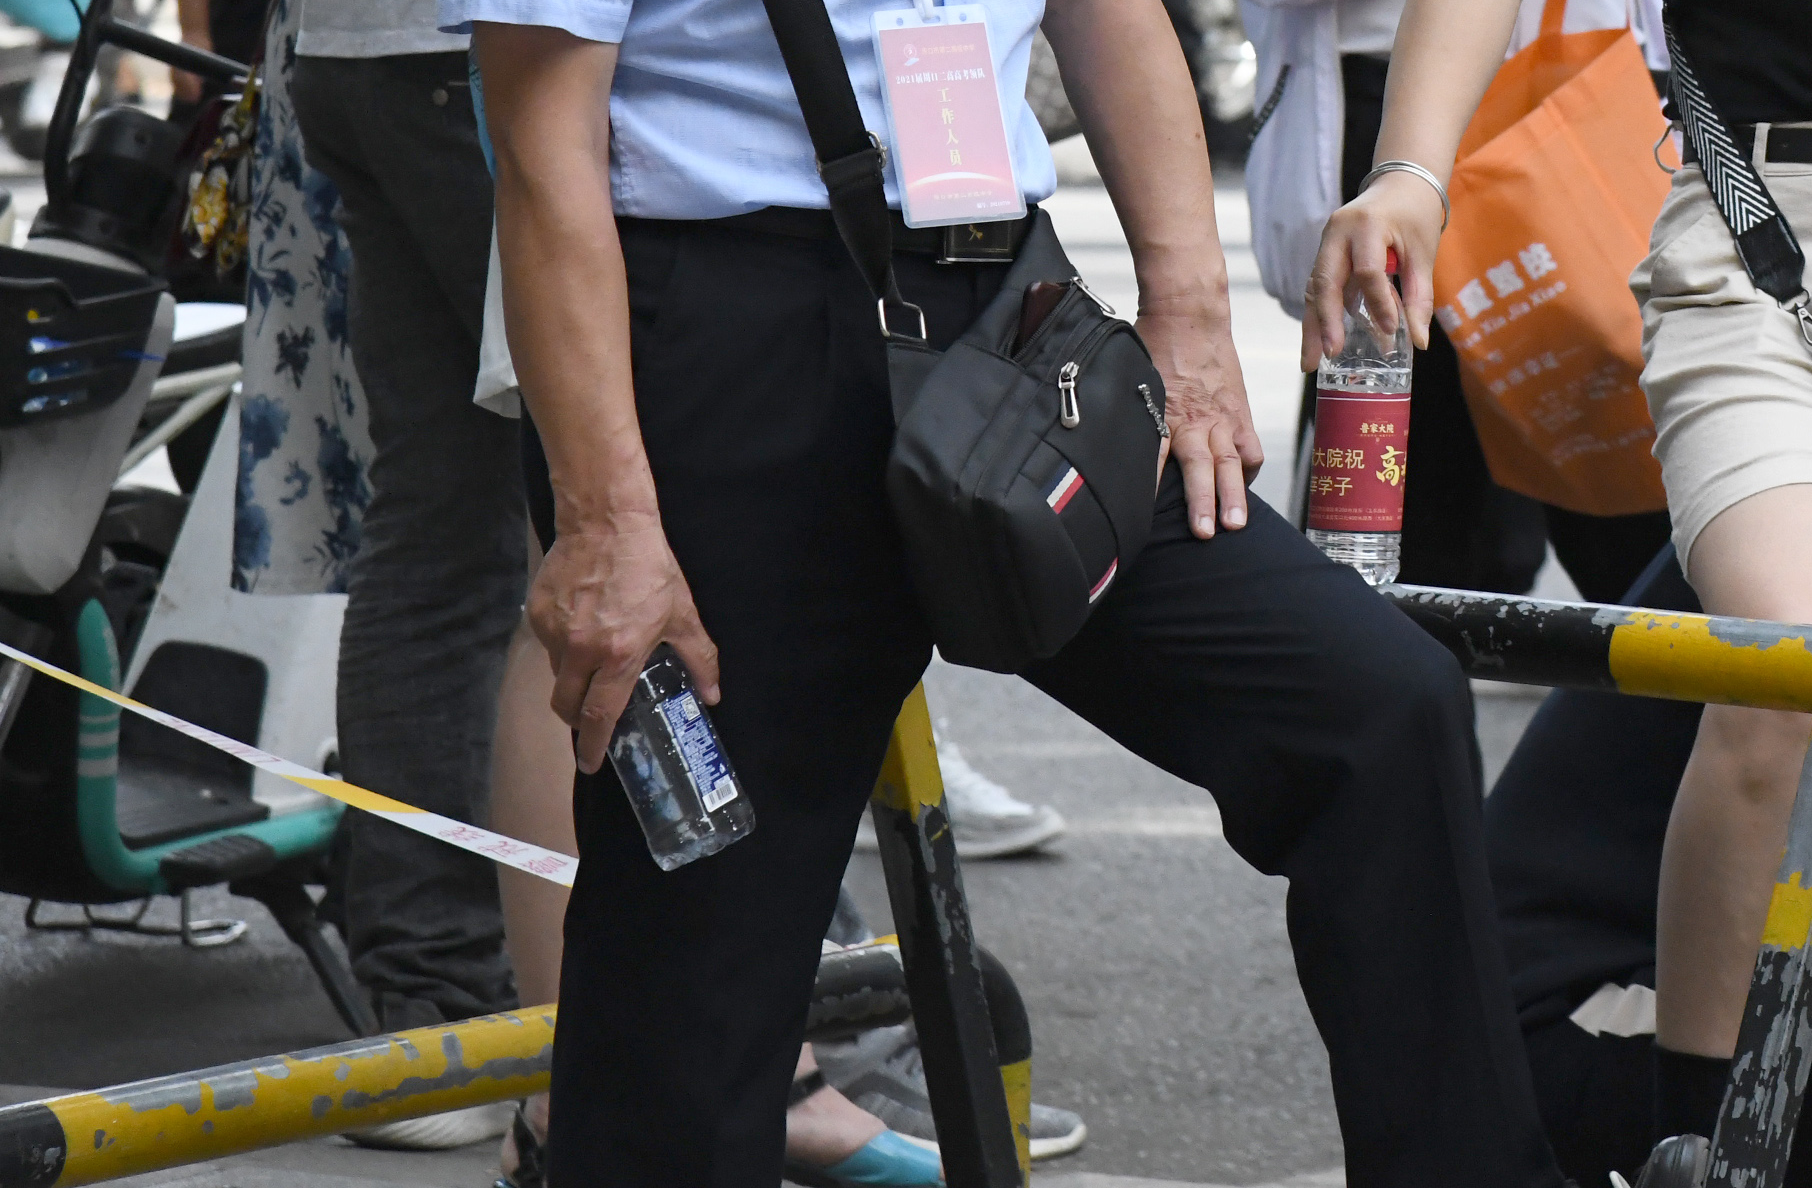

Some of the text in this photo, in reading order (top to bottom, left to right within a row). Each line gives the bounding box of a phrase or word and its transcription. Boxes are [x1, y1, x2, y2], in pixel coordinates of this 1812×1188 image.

[936, 87, 963, 166] 工作人员
[1359, 422, 1395, 434] 鲁家大院
[1311, 447, 1366, 470] 大院祝
[1375, 445, 1407, 492] 高
